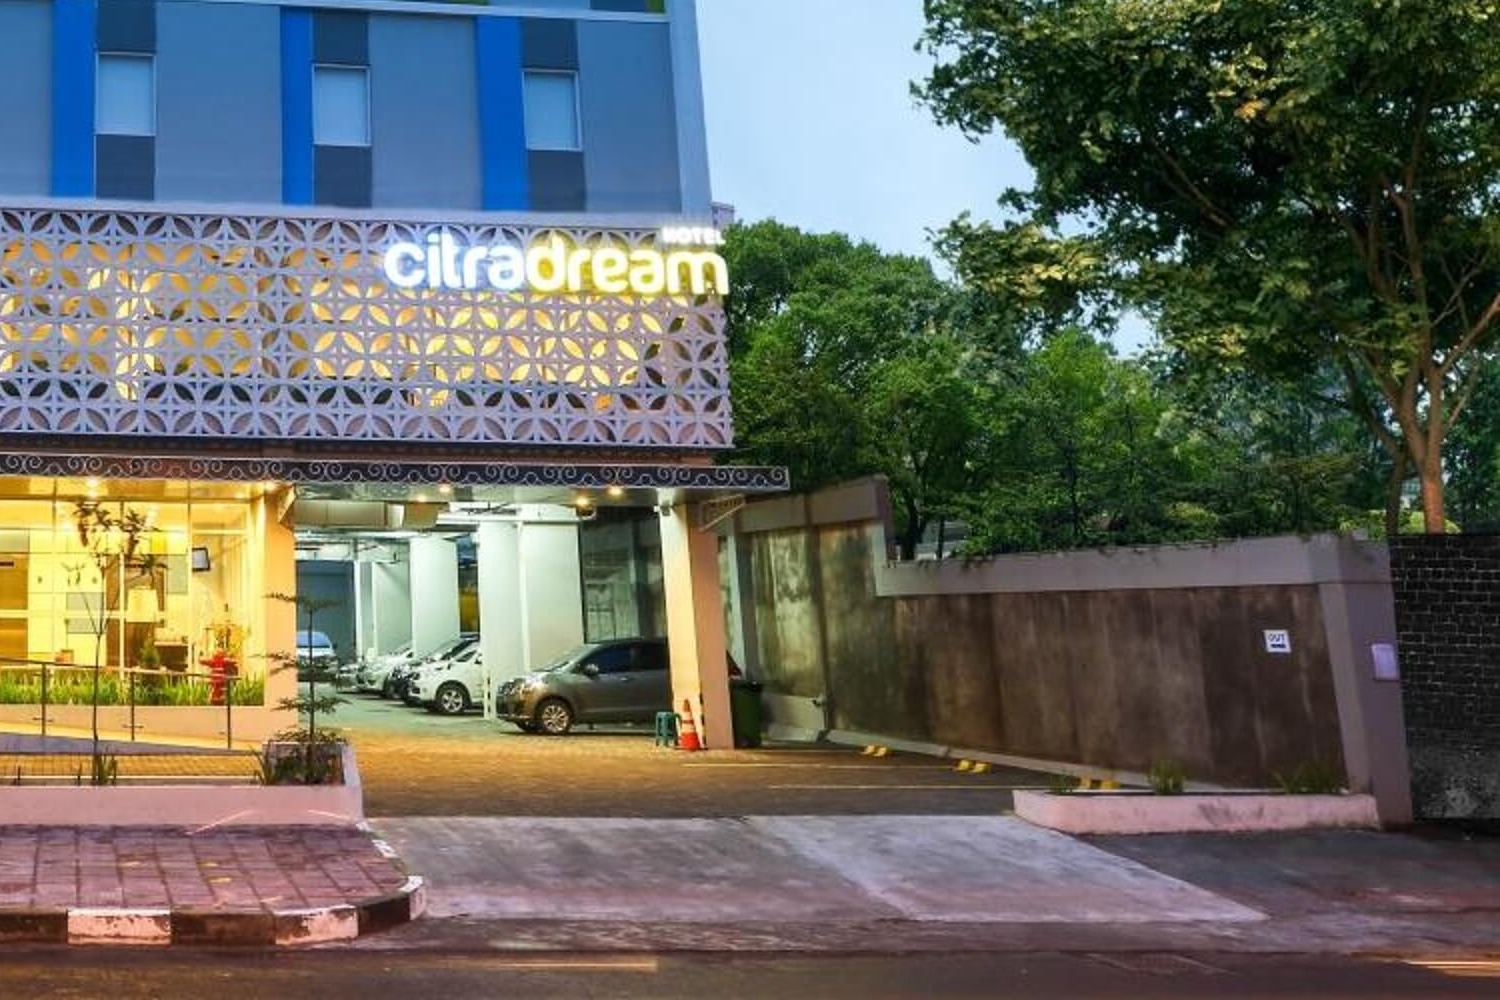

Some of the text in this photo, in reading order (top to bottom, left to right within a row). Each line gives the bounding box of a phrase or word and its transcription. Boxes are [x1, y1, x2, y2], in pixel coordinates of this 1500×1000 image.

[661, 227, 726, 244] HOTEL
[384, 232, 730, 295] citradream
[1267, 633, 1285, 643] OUT
